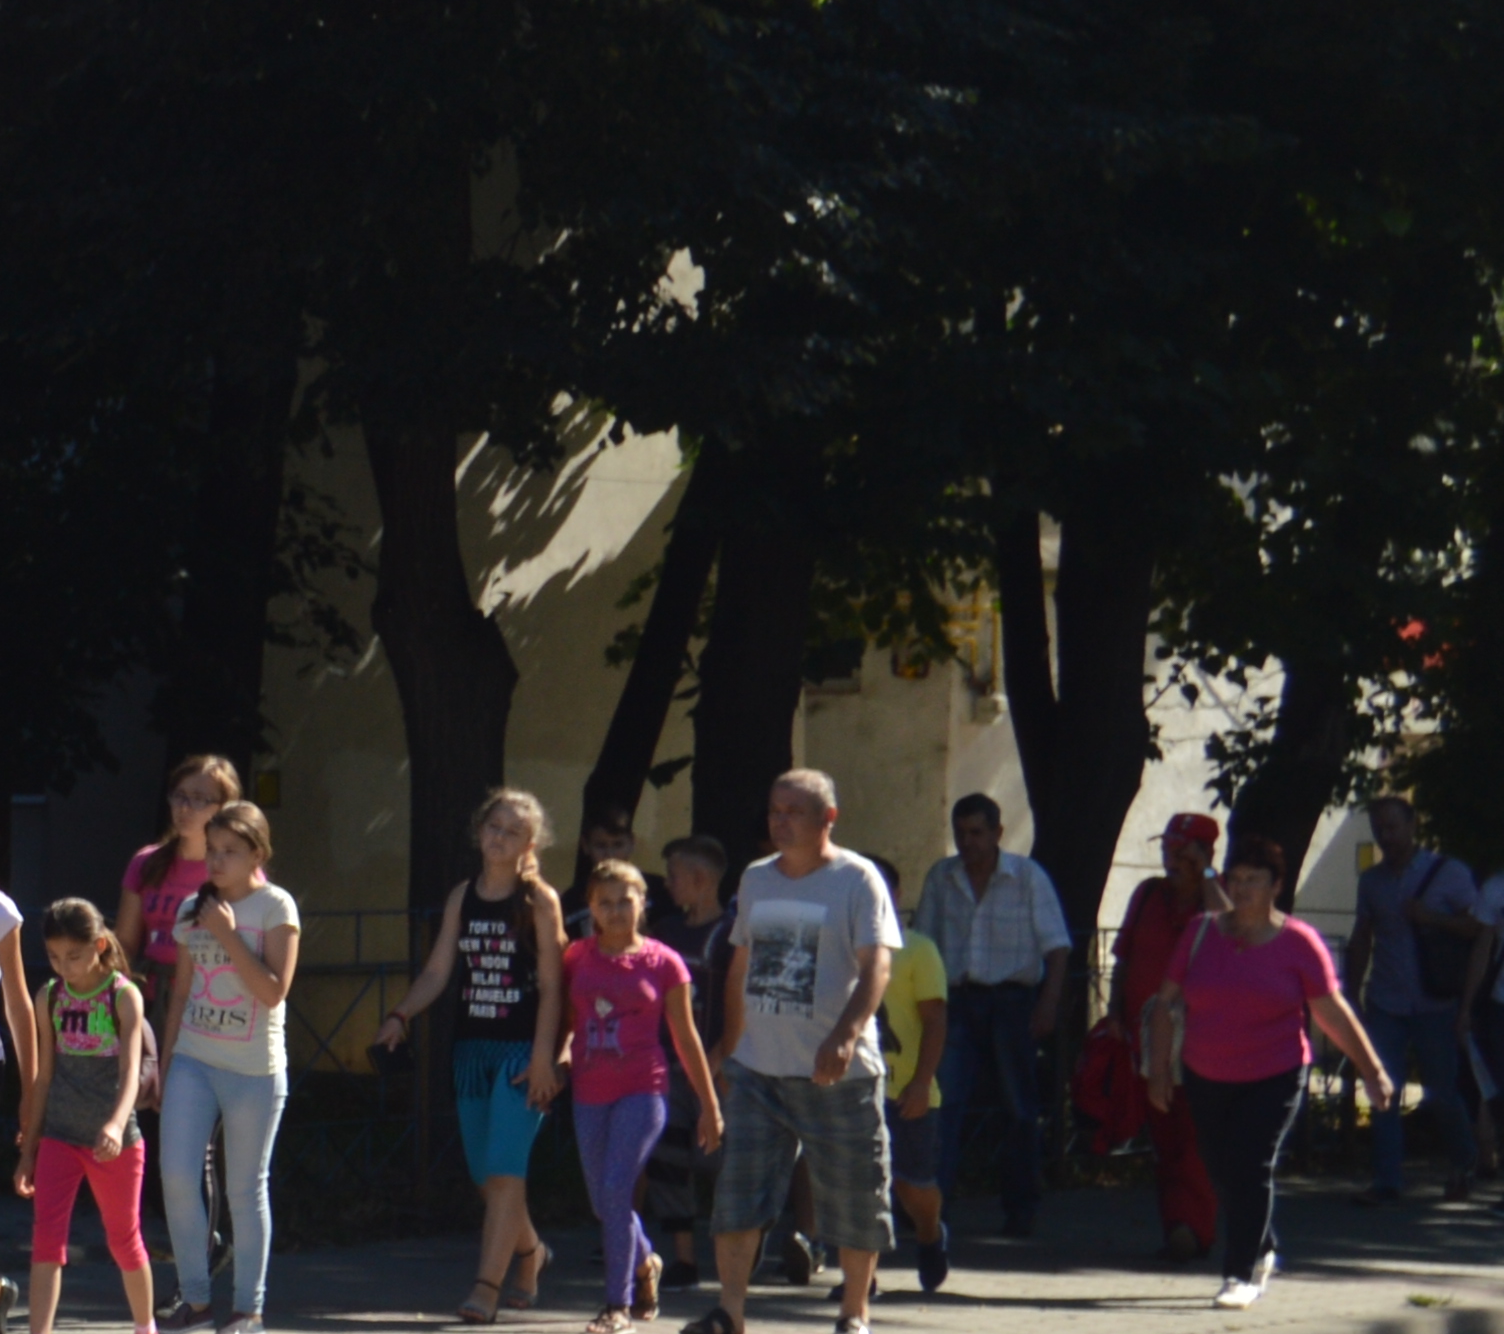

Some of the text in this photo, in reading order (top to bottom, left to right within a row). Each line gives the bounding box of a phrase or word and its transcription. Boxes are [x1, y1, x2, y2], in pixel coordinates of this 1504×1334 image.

[469, 920, 506, 935] TOKYO
[458, 938, 481, 953] NEW
[475, 987, 520, 1004] ANGELES
